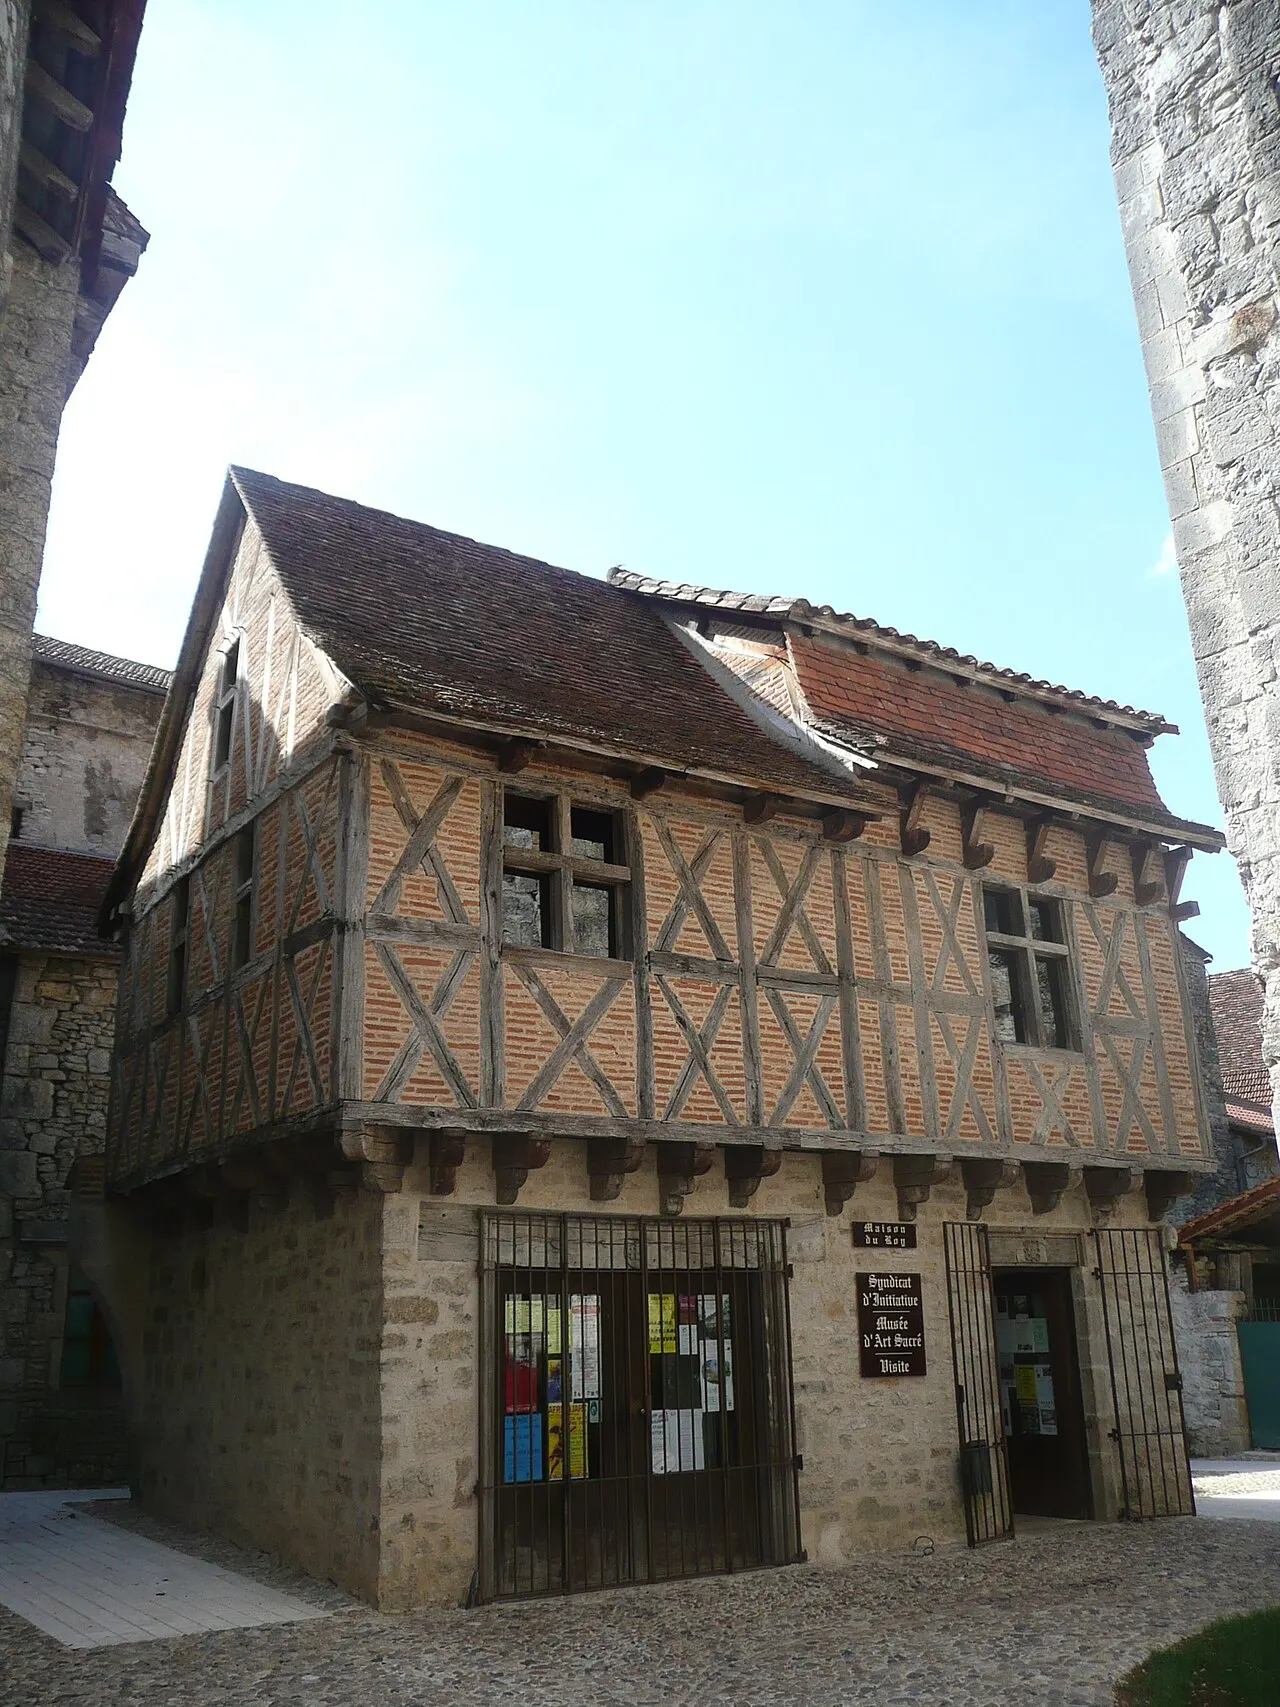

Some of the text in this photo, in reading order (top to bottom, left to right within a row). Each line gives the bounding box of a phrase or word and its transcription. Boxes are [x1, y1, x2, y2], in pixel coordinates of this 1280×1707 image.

[864, 1223, 905, 1233] Maison
[865, 1235, 905, 1247] du Roy
[868, 1274, 912, 1291] Syndicat
[862, 1292, 918, 1307] d'Initiative
[876, 1316, 908, 1330] Musée
[863, 1333, 921, 1348] d'Art Sacré
[880, 1359, 910, 1373] Visite
